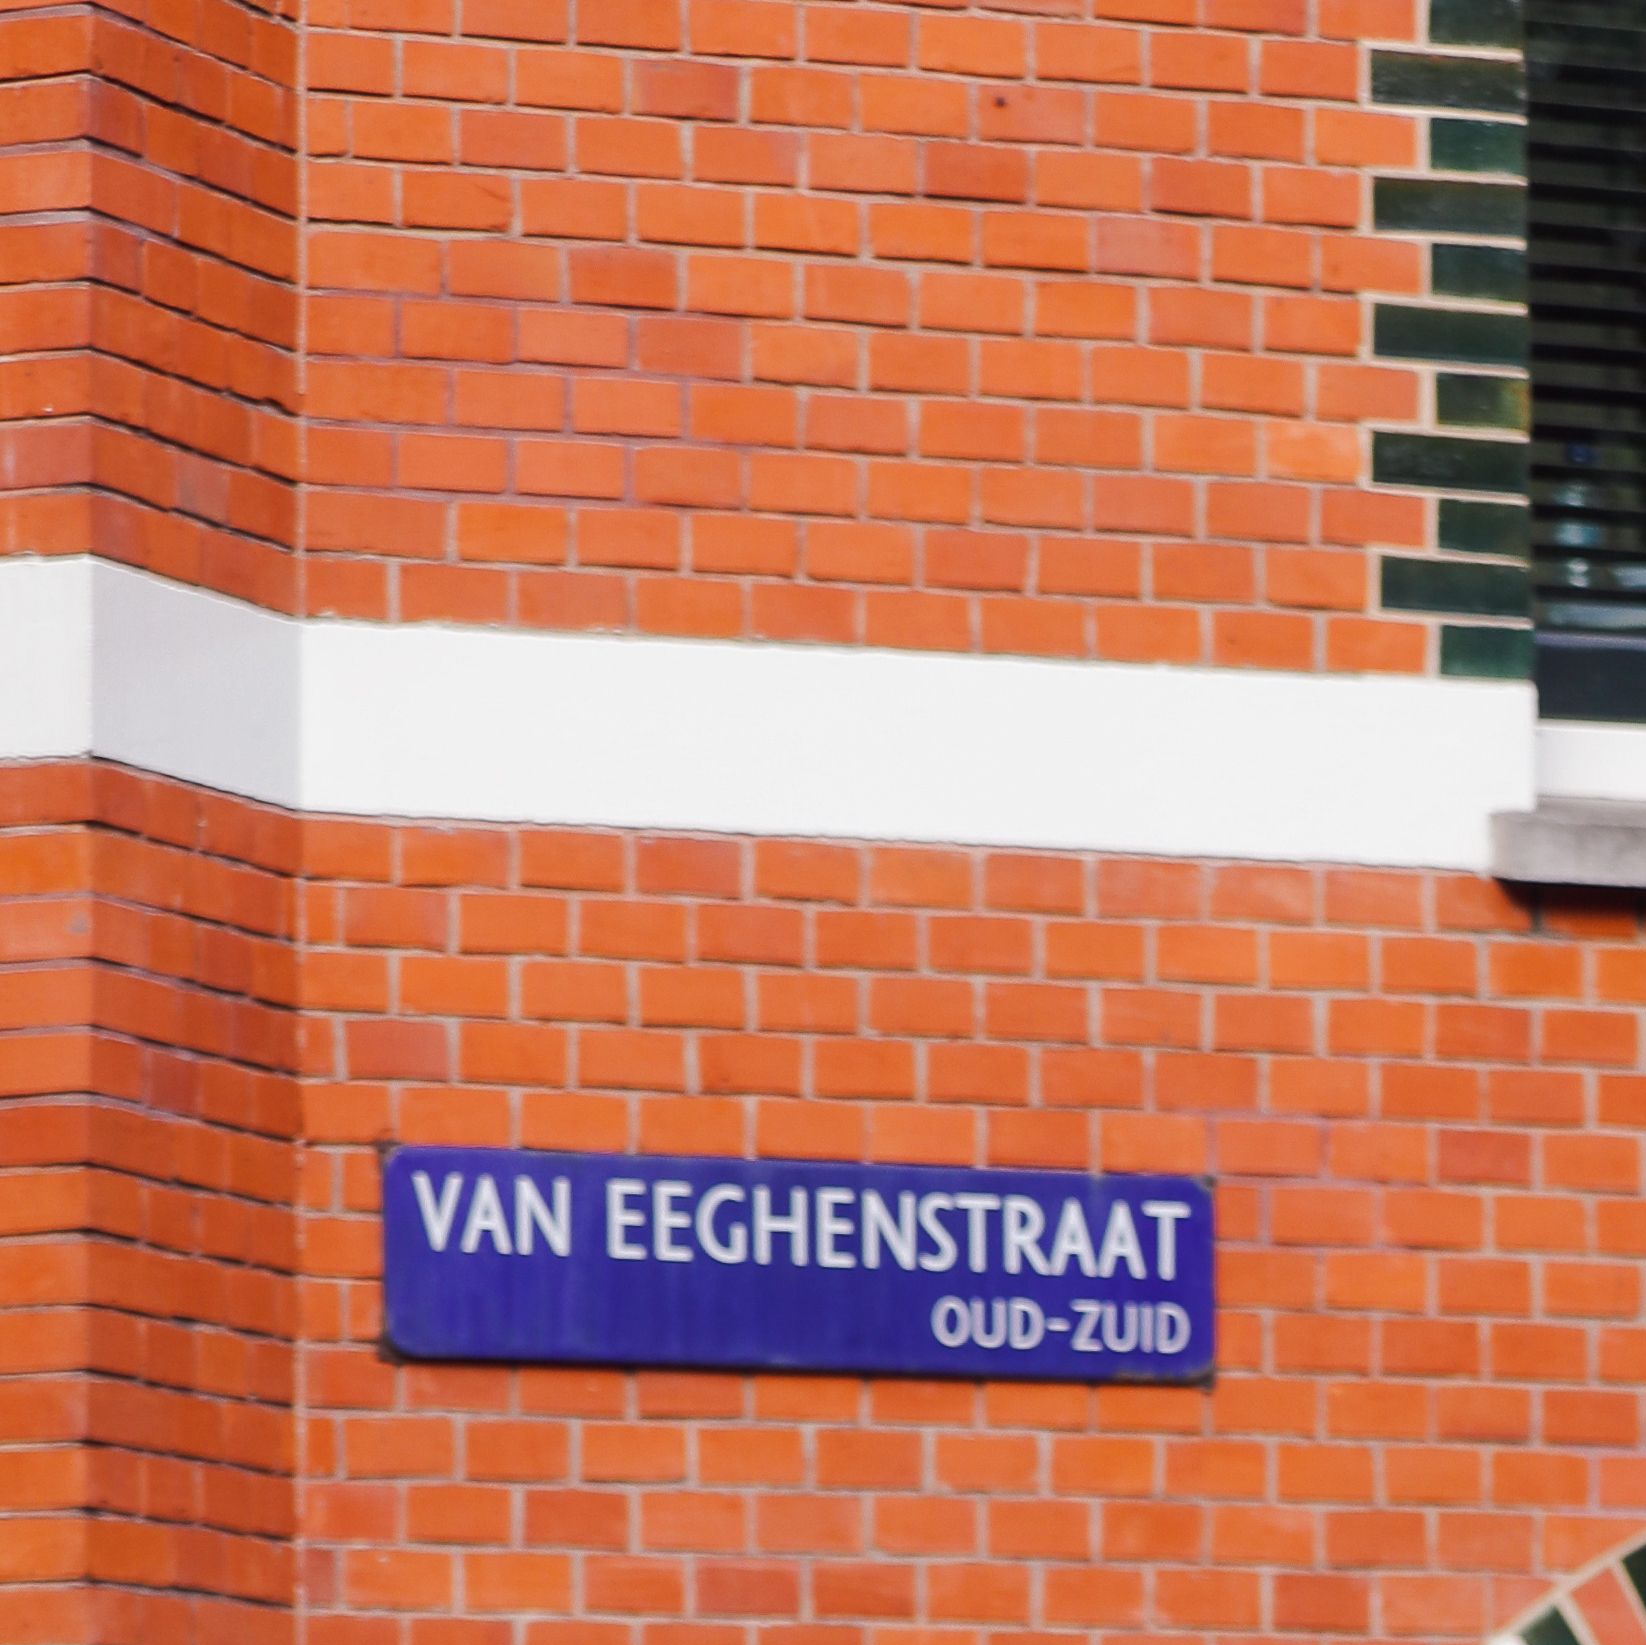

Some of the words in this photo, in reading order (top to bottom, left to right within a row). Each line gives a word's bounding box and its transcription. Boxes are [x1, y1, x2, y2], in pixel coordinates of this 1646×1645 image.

[411, 1171, 571, 1258] VAN
[605, 1178, 1192, 1281] EEGHENSTRAAT
[931, 1296, 1191, 1355] OUD-ZUID
